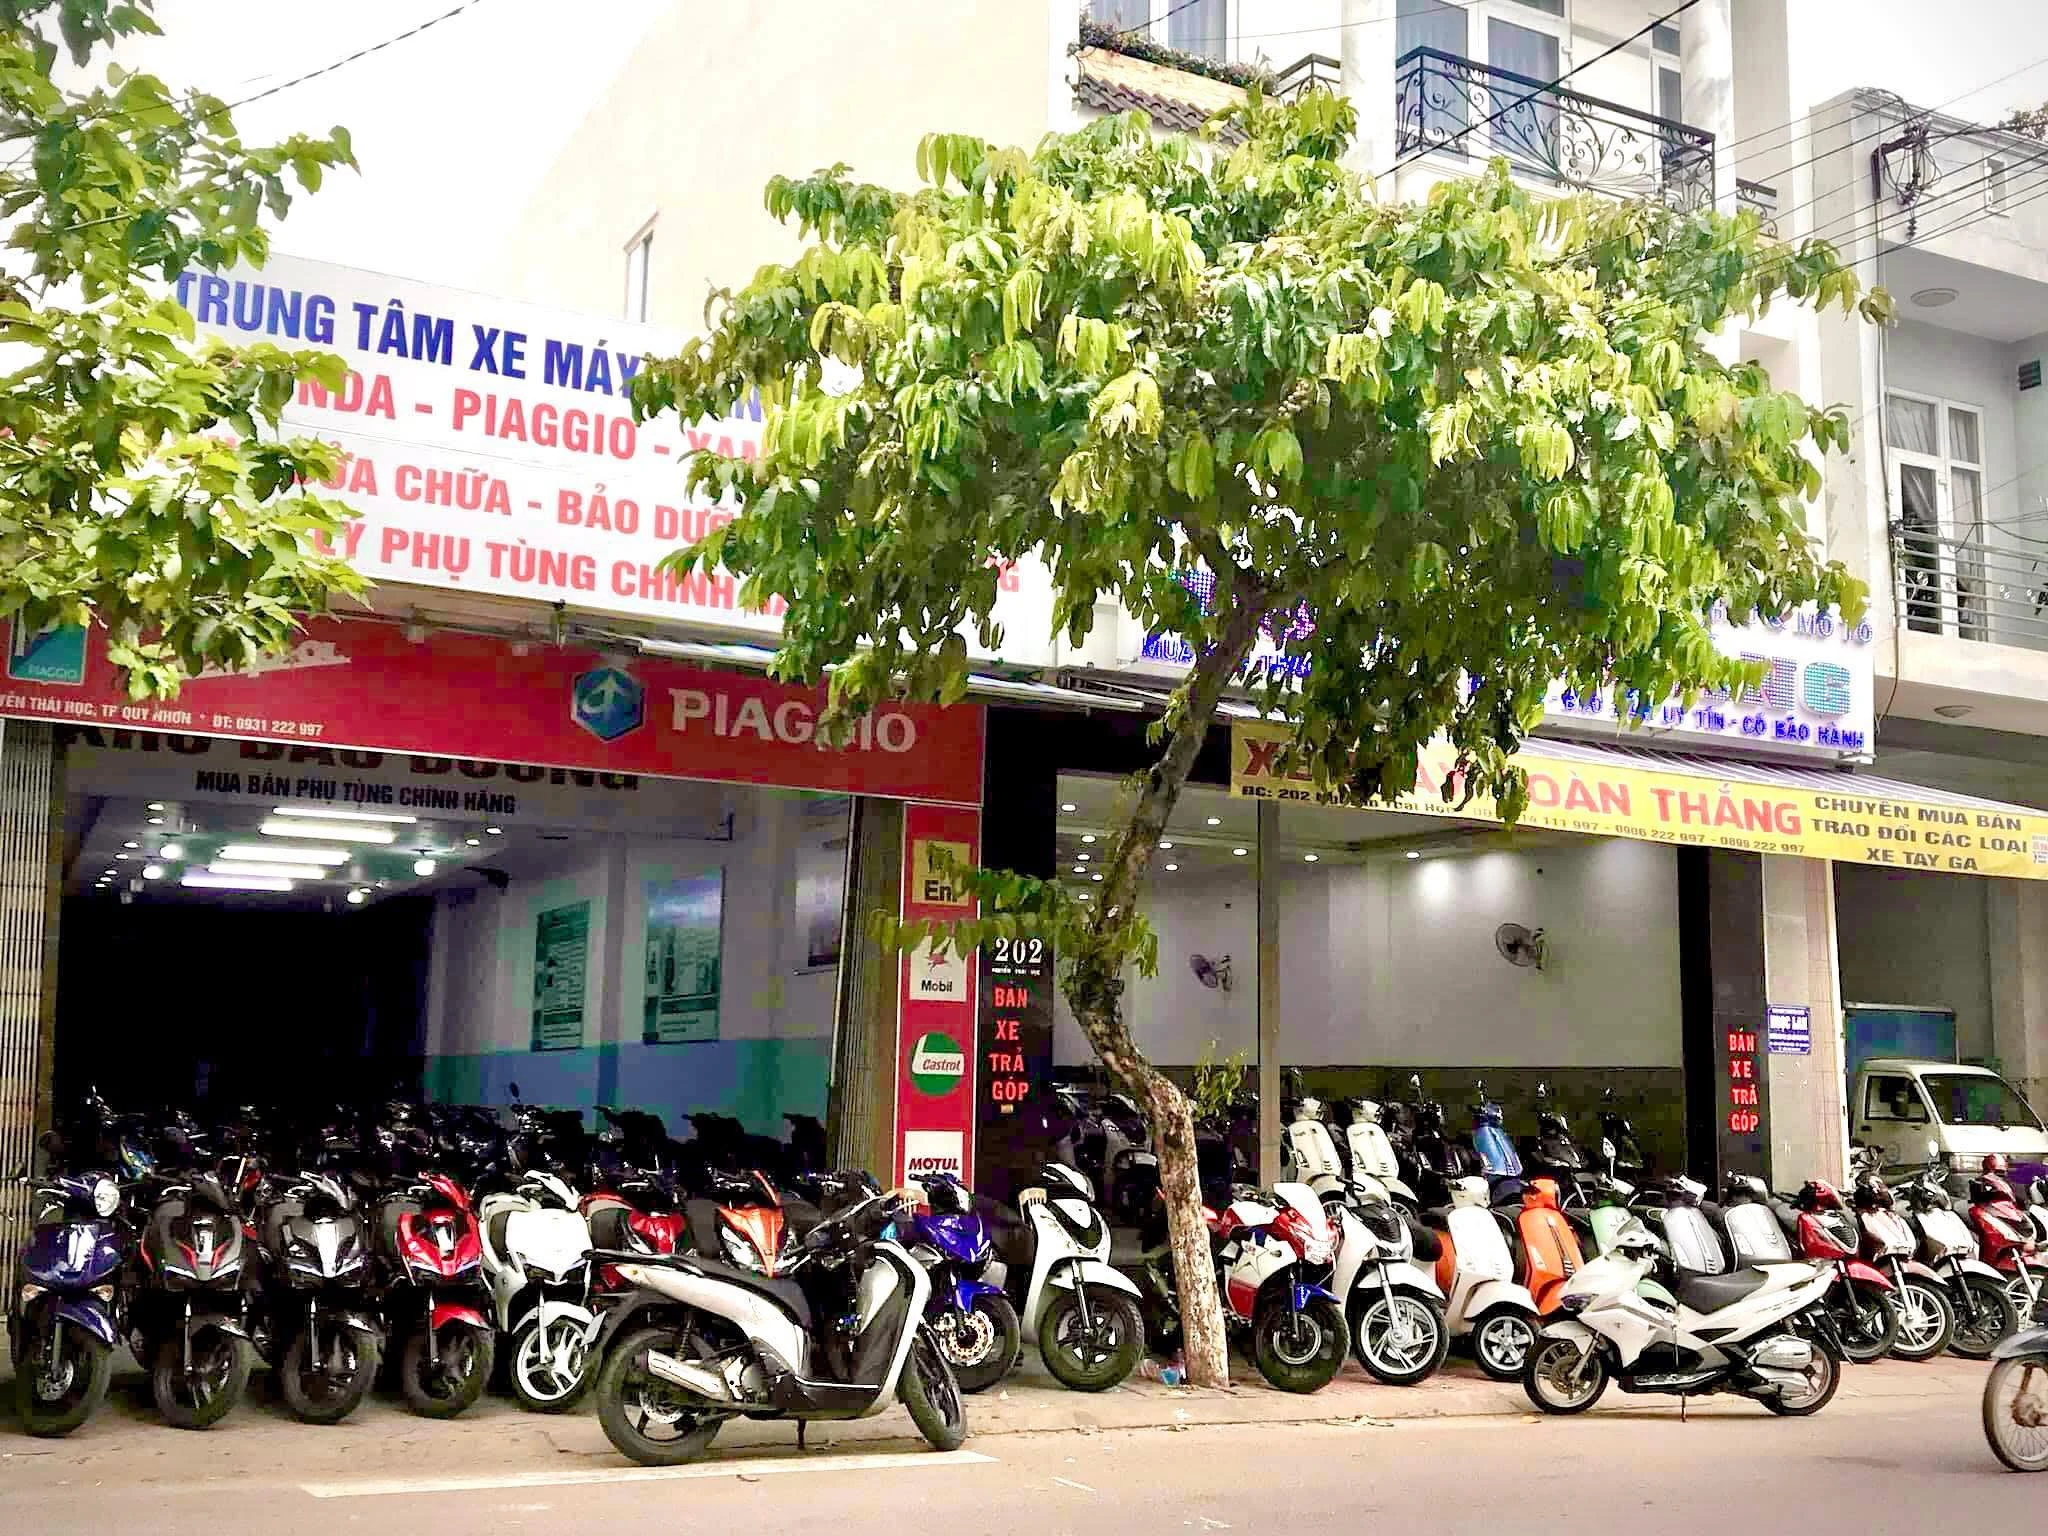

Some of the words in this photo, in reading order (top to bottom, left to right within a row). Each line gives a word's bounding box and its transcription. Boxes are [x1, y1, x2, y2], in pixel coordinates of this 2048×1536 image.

[176, 271, 335, 345] TRUNG
[352, 298, 454, 366] TÂM
[469, 324, 527, 379] XE
[543, 338, 641, 399] MÁY
[452, 388, 636, 460] PIAGGIO
[395, 463, 512, 515] CHỮA
[557, 483, 639, 534] BẢO
[381, 526, 471, 581] PHỤ
[486, 538, 597, 591] TÙNG
[235, 717, 267, 733] 0931
[271, 721, 296, 735] 222
[299, 724, 324, 737] 997
[195, 770, 241, 794] MUA
[247, 772, 290, 797] BÁN
[1527, 770, 1632, 816] OÀN
[1650, 783, 1801, 835] THẮNG
[1814, 796, 1910, 819] CHUYÊN
[1917, 808, 1968, 826] MUA
[1976, 813, 2022, 832] BÁN
[1278, 788, 1310, 800] 202
[1651, 829, 1676, 840] 222
[1680, 833, 1706, 844] 997
[1753, 840, 1777, 852] 222
[1781, 844, 1806, 854] 997
[1811, 818, 1870, 837] TRAO
[1924, 830, 1971, 848] CÁC
[1979, 836, 2027, 856] LOẠI
[1866, 847, 1896, 862] XE
[1902, 851, 1940, 867] TAY
[1948, 856, 1978, 871] GA
[995, 937, 1043, 964] 202
[921, 980, 953, 993] Mobil
[995, 1019, 1021, 1041] XE
[1729, 1027, 1755, 1052] BÁN
[922, 1058, 961, 1072] Castrol
[1731, 1060, 1752, 1078] XE
[991, 1075, 1029, 1101] GÓP
[1732, 1083, 1758, 1105] TRẢ
[1731, 1109, 1759, 1132] GÓP
[908, 1158, 960, 1171] MOTUL
